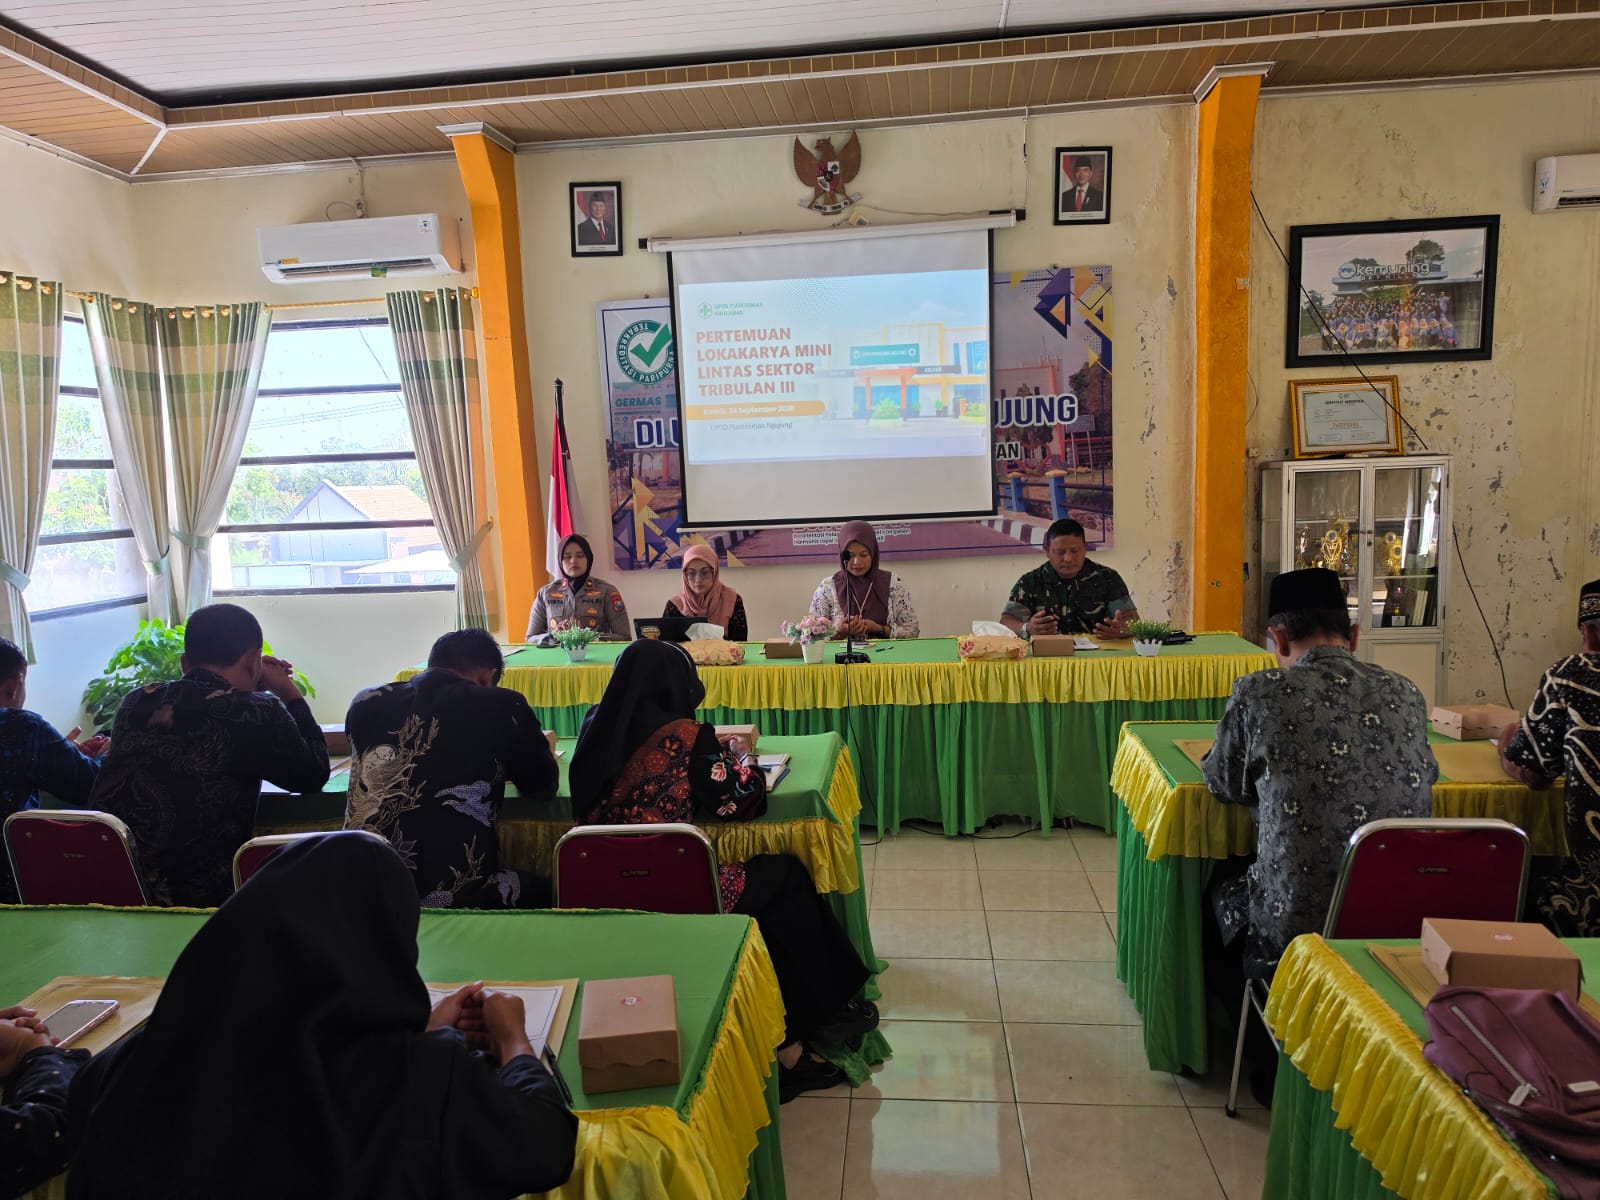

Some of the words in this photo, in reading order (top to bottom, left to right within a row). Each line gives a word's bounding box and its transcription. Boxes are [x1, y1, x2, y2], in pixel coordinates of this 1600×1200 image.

[696, 328, 791, 344] PERTEMUAN
[618, 322, 649, 378] TERAKREDITASI
[697, 345, 790, 362] LOKAKARYA
[795, 343, 832, 358] MINI
[698, 365, 752, 380] LINTAS
[756, 362, 815, 377] SEKTOR
[698, 382, 775, 397] TRIBULAN
[780, 380, 795, 394] III
[615, 396, 662, 408] GERMAS
[634, 418, 666, 448] DI
